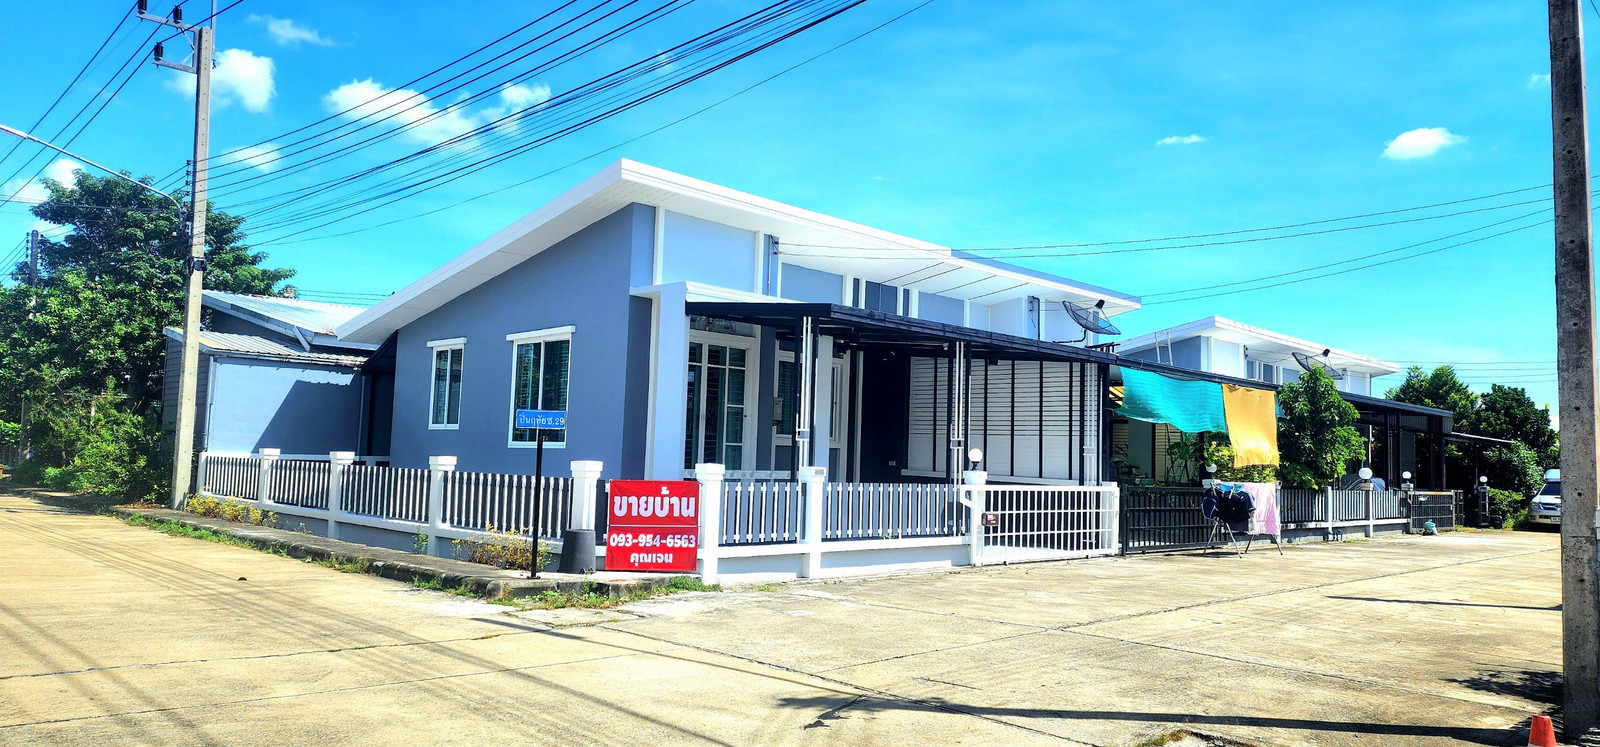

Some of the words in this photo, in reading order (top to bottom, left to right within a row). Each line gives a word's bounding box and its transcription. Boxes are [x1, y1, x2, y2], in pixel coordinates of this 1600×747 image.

[613, 486, 696, 518] ขายบ้าน
[609, 533, 696, 548] 093-954-6563
[630, 552, 673, 567] คุณเจน
